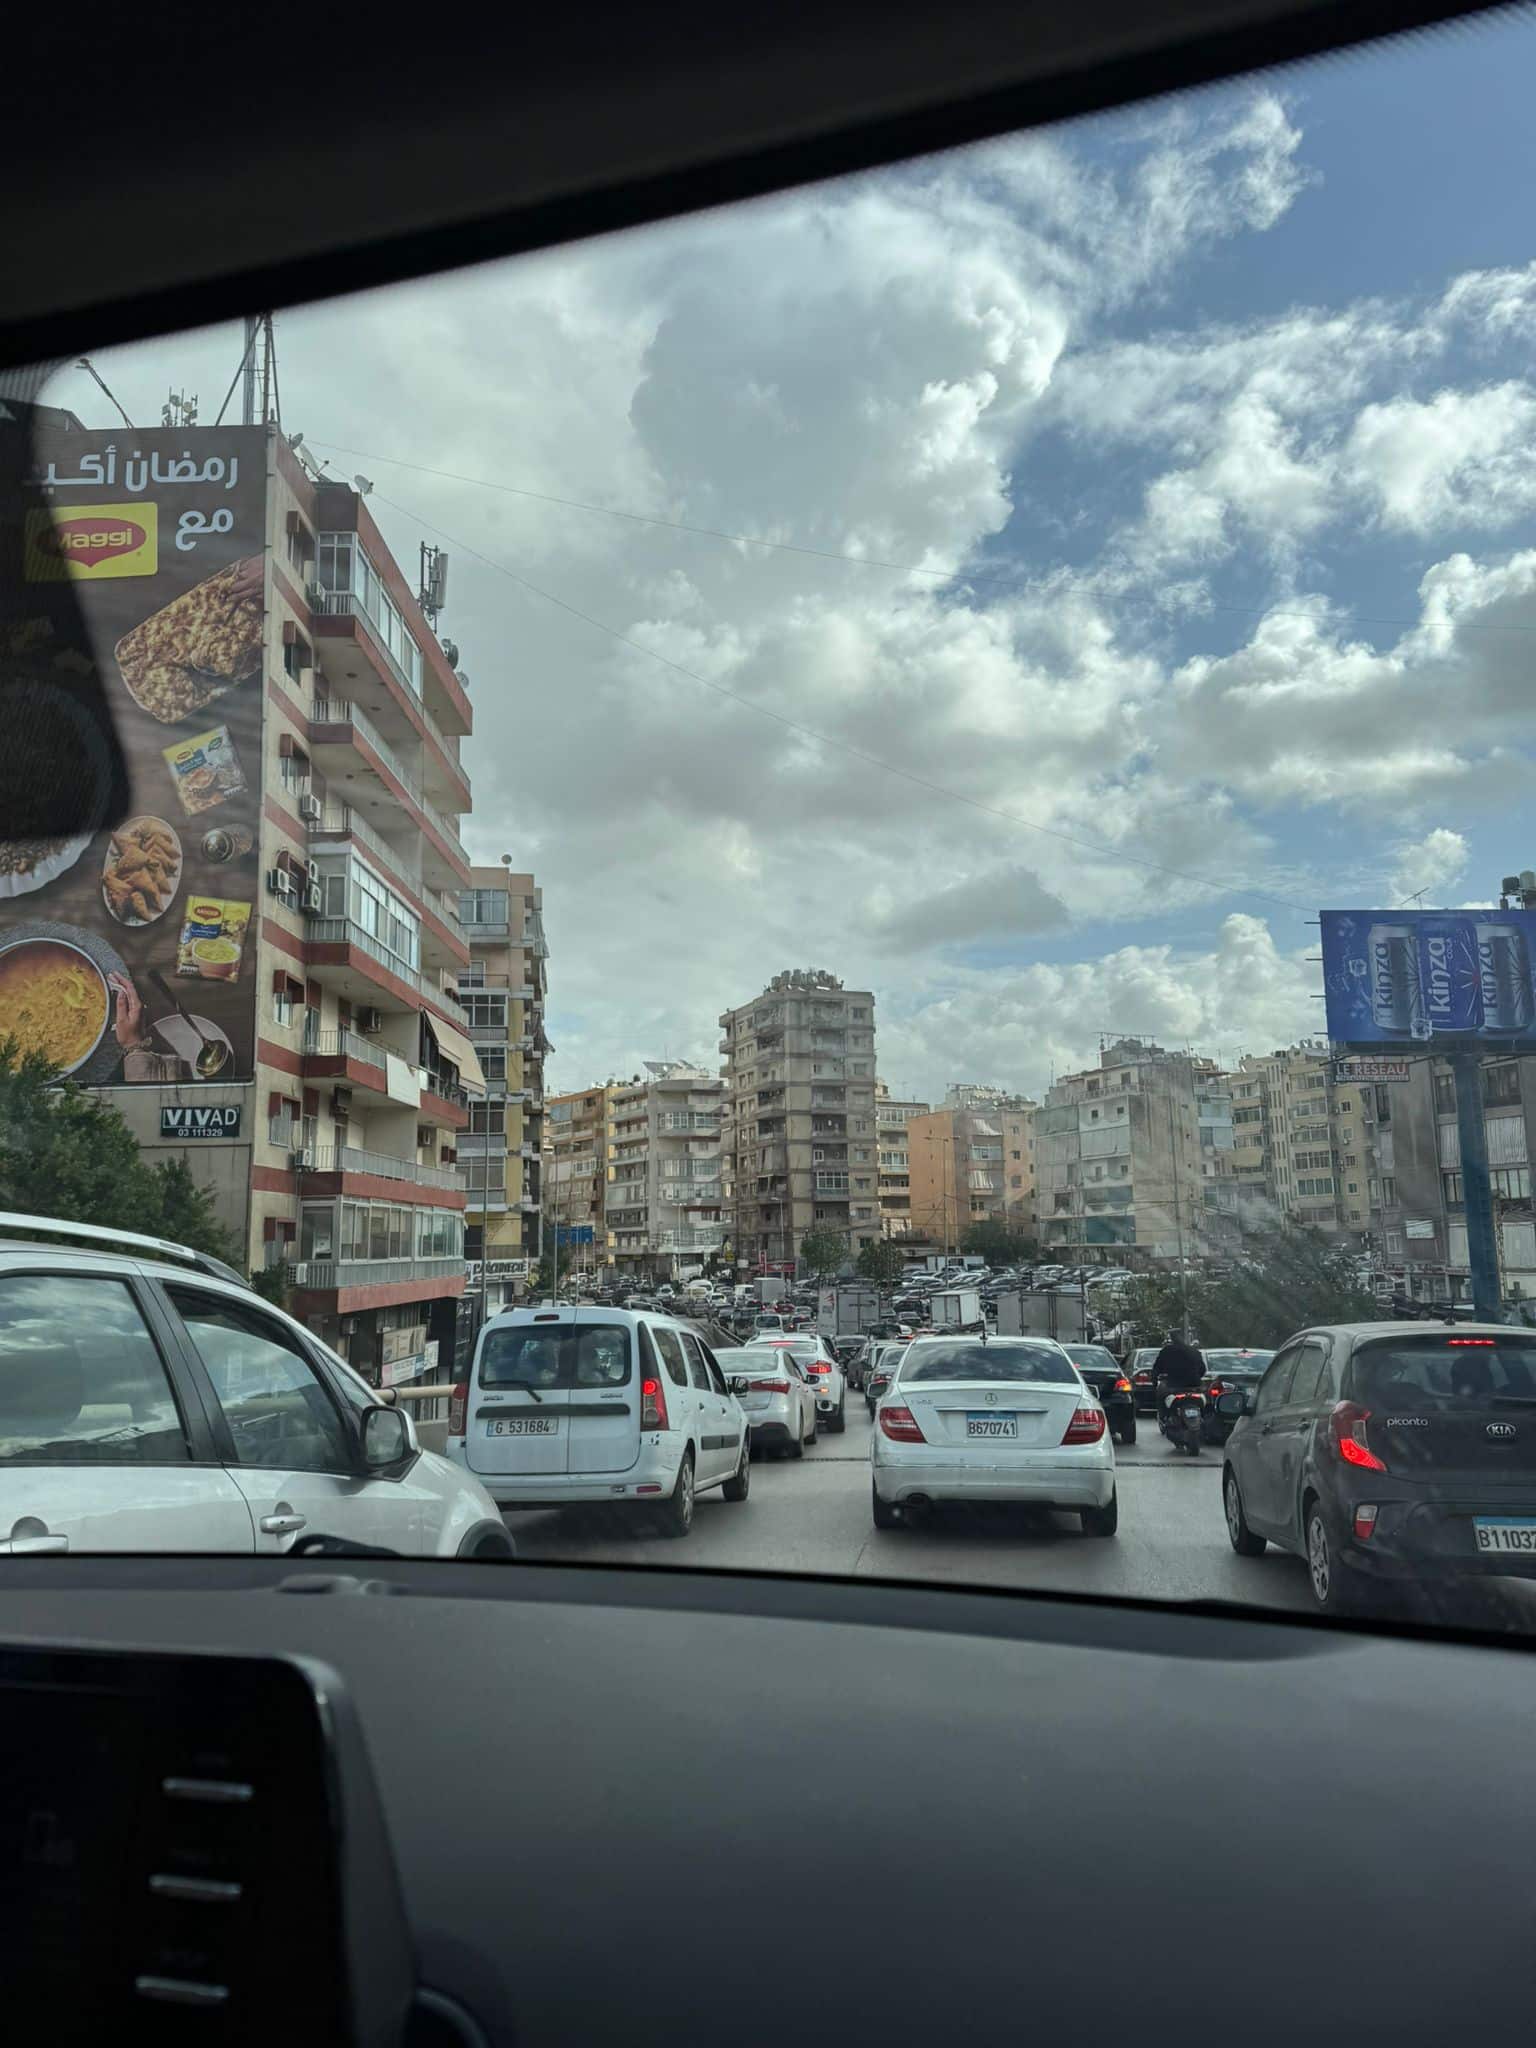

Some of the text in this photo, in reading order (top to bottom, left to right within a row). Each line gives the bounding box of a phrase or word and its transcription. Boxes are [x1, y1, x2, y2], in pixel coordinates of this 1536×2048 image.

[125, 450, 238, 492] رمضان
[175, 508, 234, 551] مع
[1375, 943, 1393, 1009] kinza
[1428, 937, 1451, 1012] kinza
[1336, 1063, 1351, 1075] LE
[166, 1109, 237, 1126] VIVAD
[178, 1128, 189, 1137] 03
[495, 1420, 550, 1434] G 531684
[968, 1421, 1016, 1435] B670741
